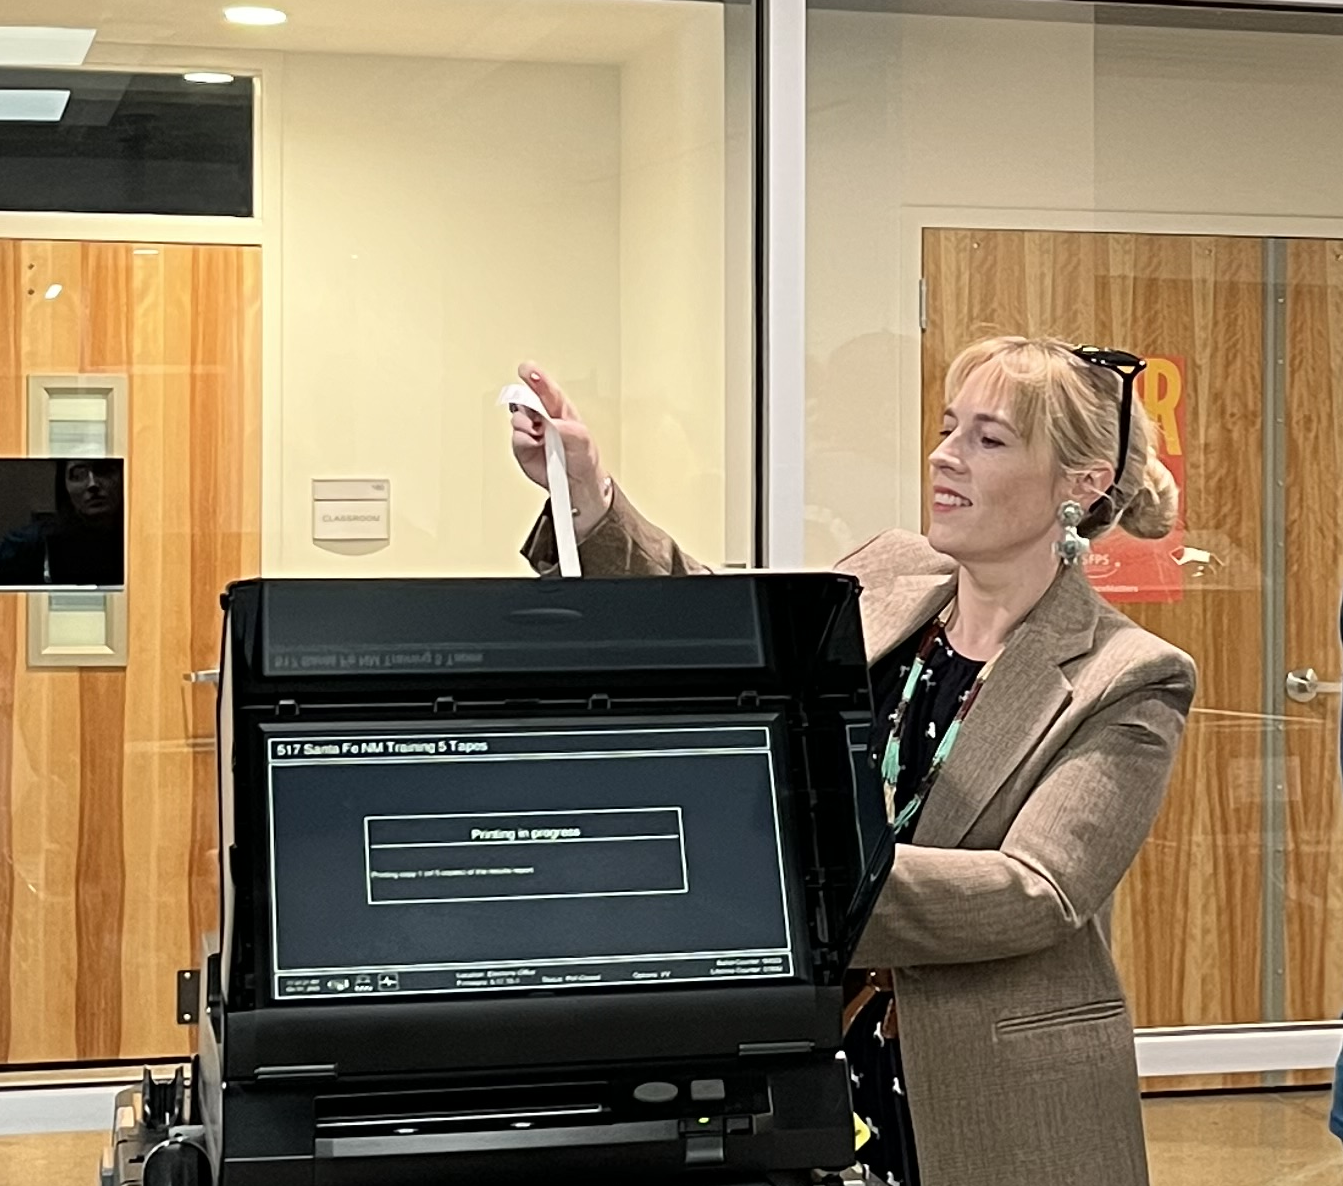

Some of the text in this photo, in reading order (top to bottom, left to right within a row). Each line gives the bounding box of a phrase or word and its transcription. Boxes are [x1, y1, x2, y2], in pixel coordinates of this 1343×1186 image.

[321, 514, 381, 523] CLASSROOM
[276, 740, 488, 756] 517 Santa Fe NM Training 5 Tapes
[471, 828, 581, 841] Printing in progress
